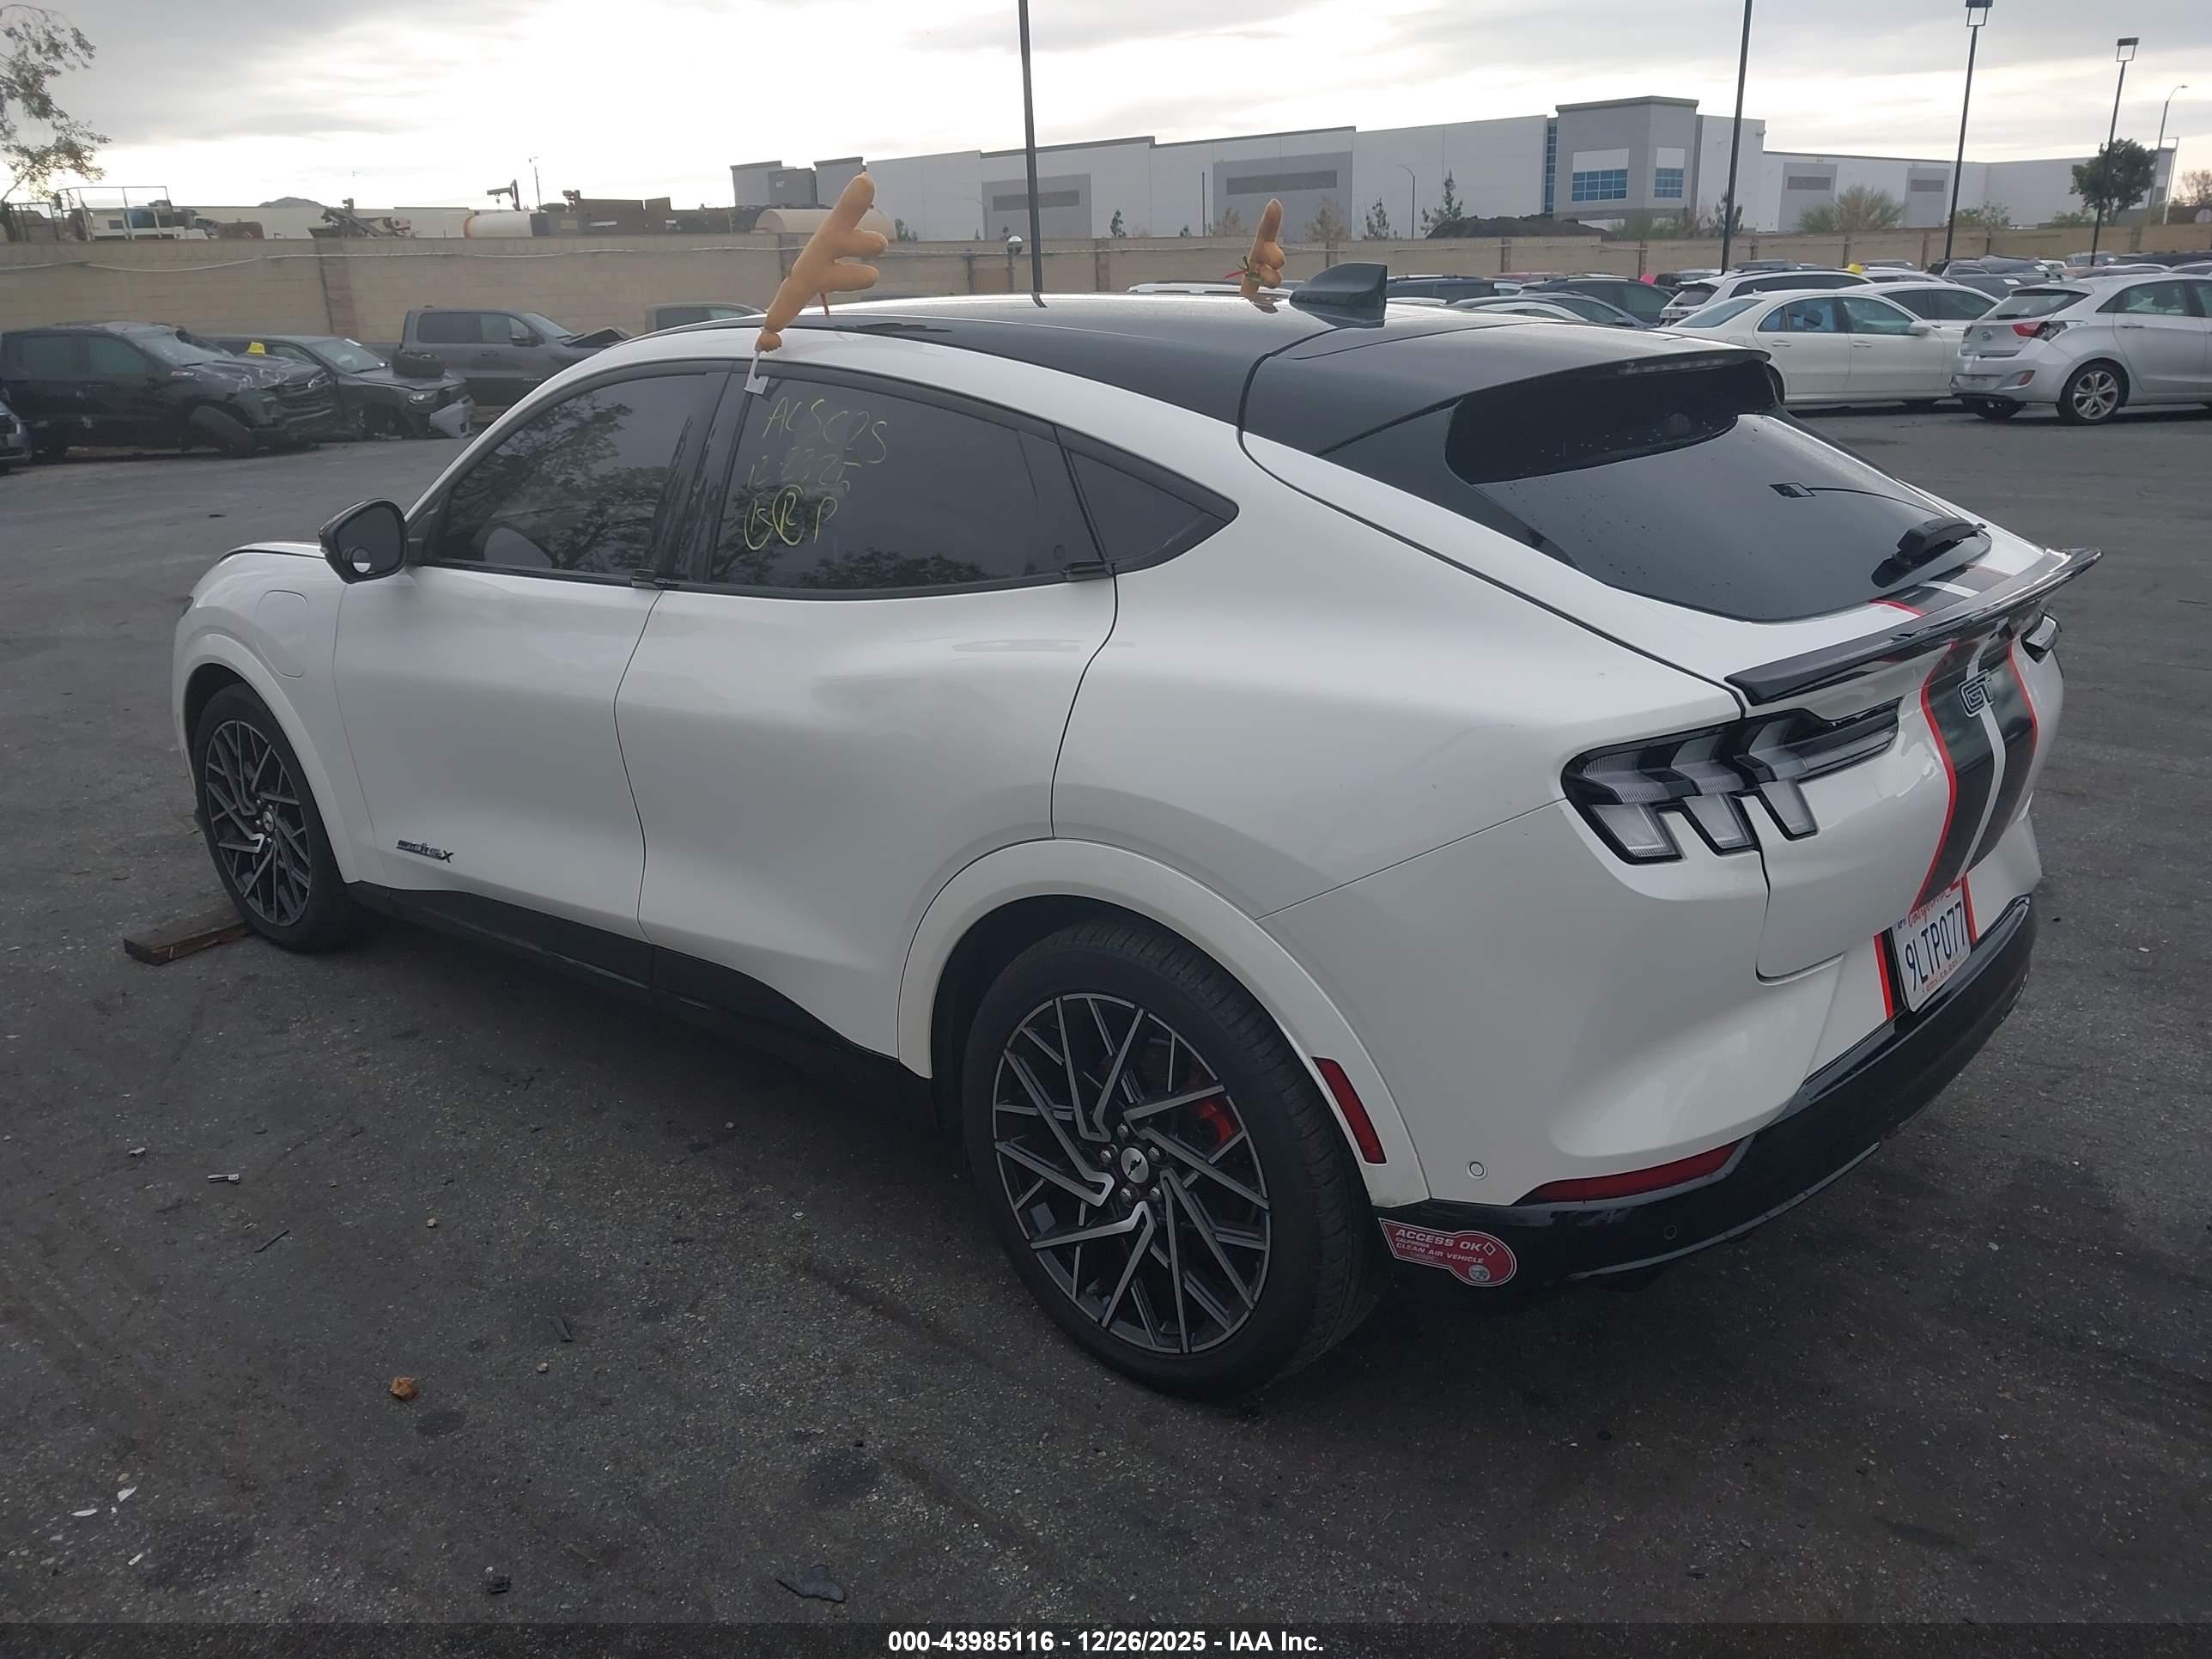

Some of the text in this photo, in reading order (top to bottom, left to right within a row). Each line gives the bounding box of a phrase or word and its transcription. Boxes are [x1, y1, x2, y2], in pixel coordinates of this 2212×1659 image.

[1958, 669, 1994, 718] GT
[1905, 900, 1966, 993] 9LTP077
[1395, 1229, 1483, 1251] ACCESS OK
[1395, 1237, 1430, 1248] CALIFORNIA
[1396, 1242, 1425, 1253] CLEAN
[1446, 1253, 1484, 1263] VEHICLE
